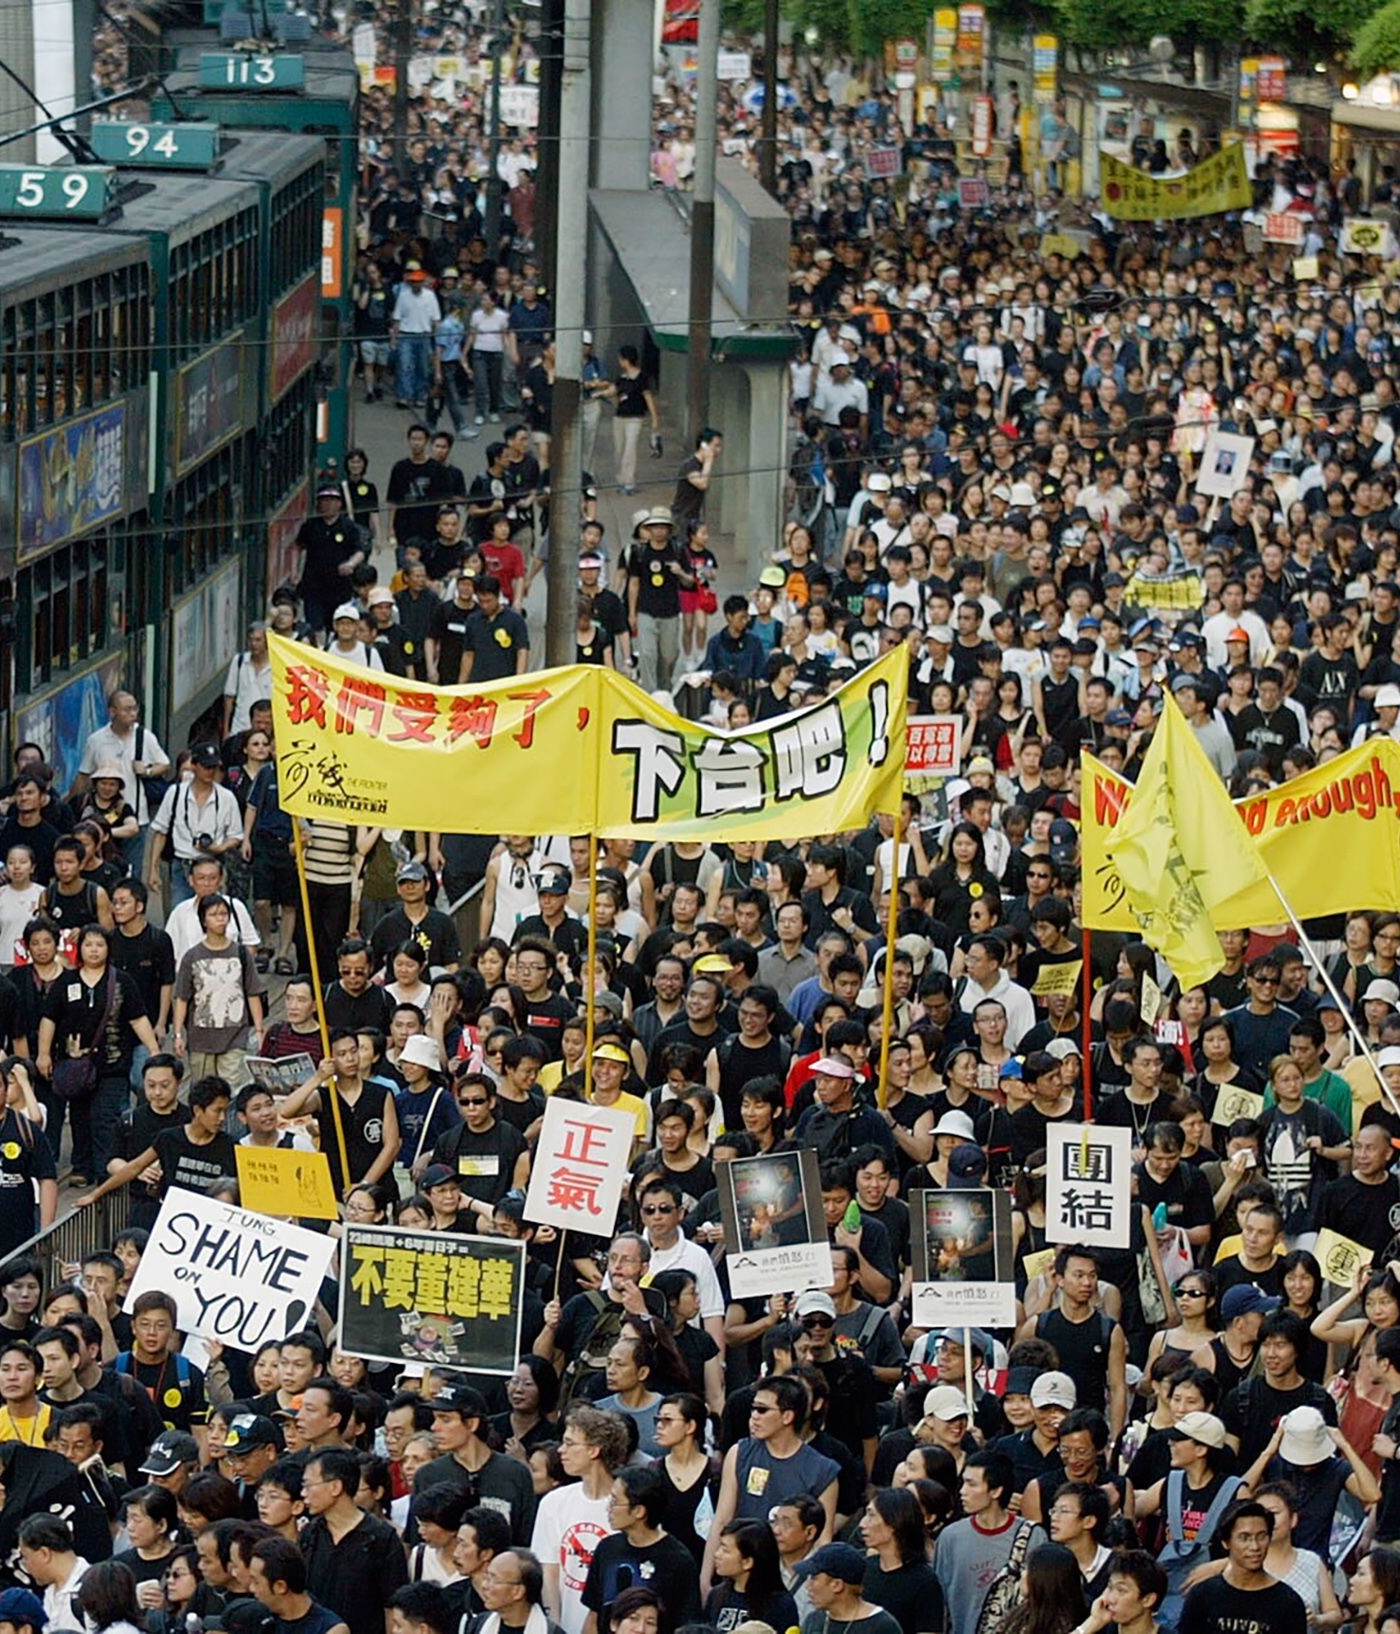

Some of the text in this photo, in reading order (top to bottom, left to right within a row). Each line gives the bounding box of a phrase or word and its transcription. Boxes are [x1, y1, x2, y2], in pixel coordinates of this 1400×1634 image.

[226, 59, 276, 84] 113
[125, 126, 179, 158] 94
[547, 1118, 614, 1217] 正氣
[1060, 1141, 1115, 1231] 團結
[221, 1206, 278, 1238] TUNG
[158, 1212, 309, 1294] SHAME
[174, 1266, 202, 1287] ON
[351, 1244, 514, 1321] 不要董建華
